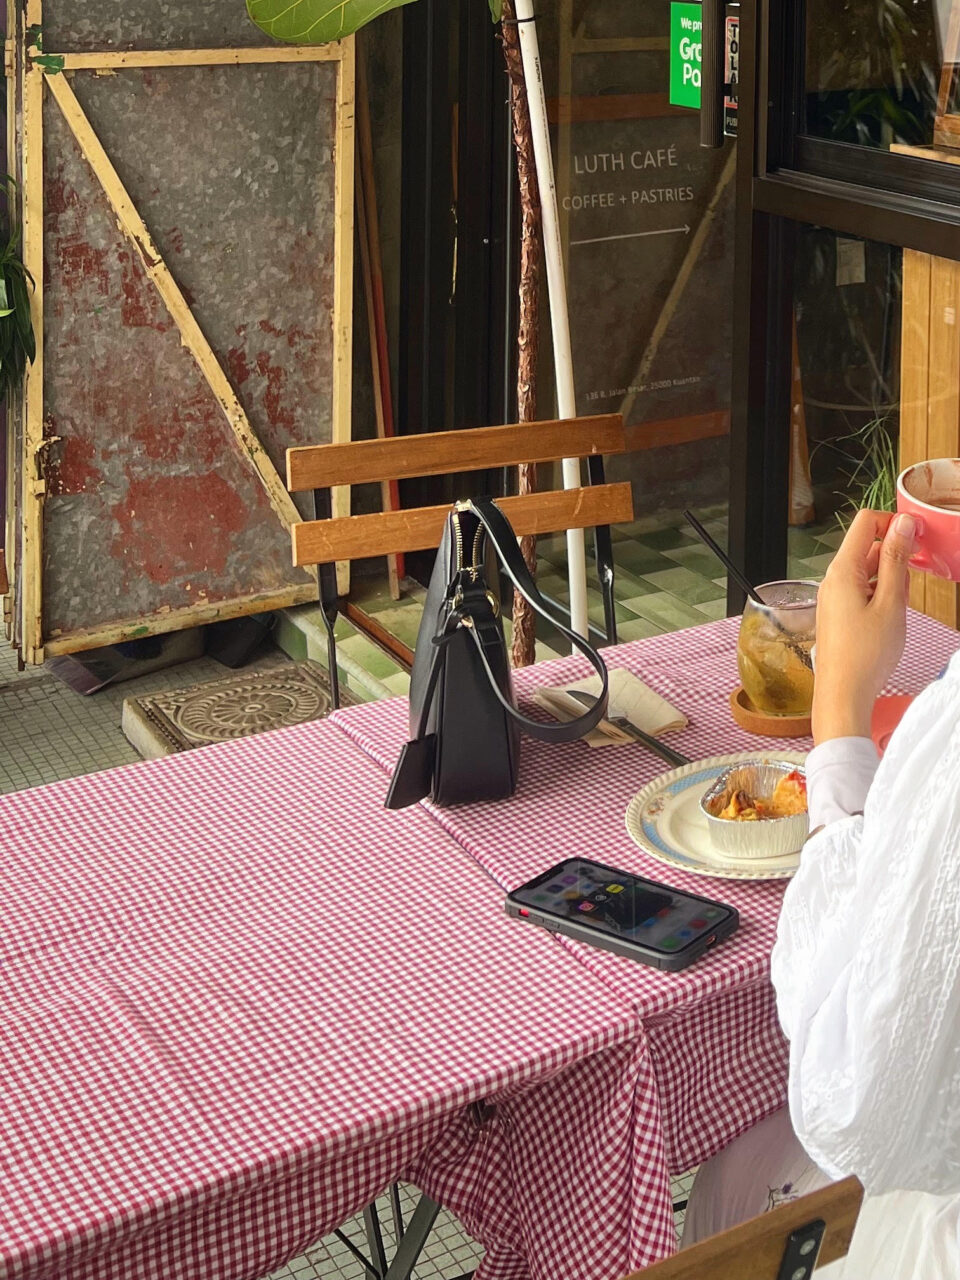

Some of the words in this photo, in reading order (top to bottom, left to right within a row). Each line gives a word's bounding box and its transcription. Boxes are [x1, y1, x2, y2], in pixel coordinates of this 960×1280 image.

[680, 17, 692, 29] We
[573, 152, 625, 174] LUTH
[630, 144, 678, 170] CAFÉ
[562, 193, 615, 211] COFFEE
[631, 187, 694, 204] PASTRIES
